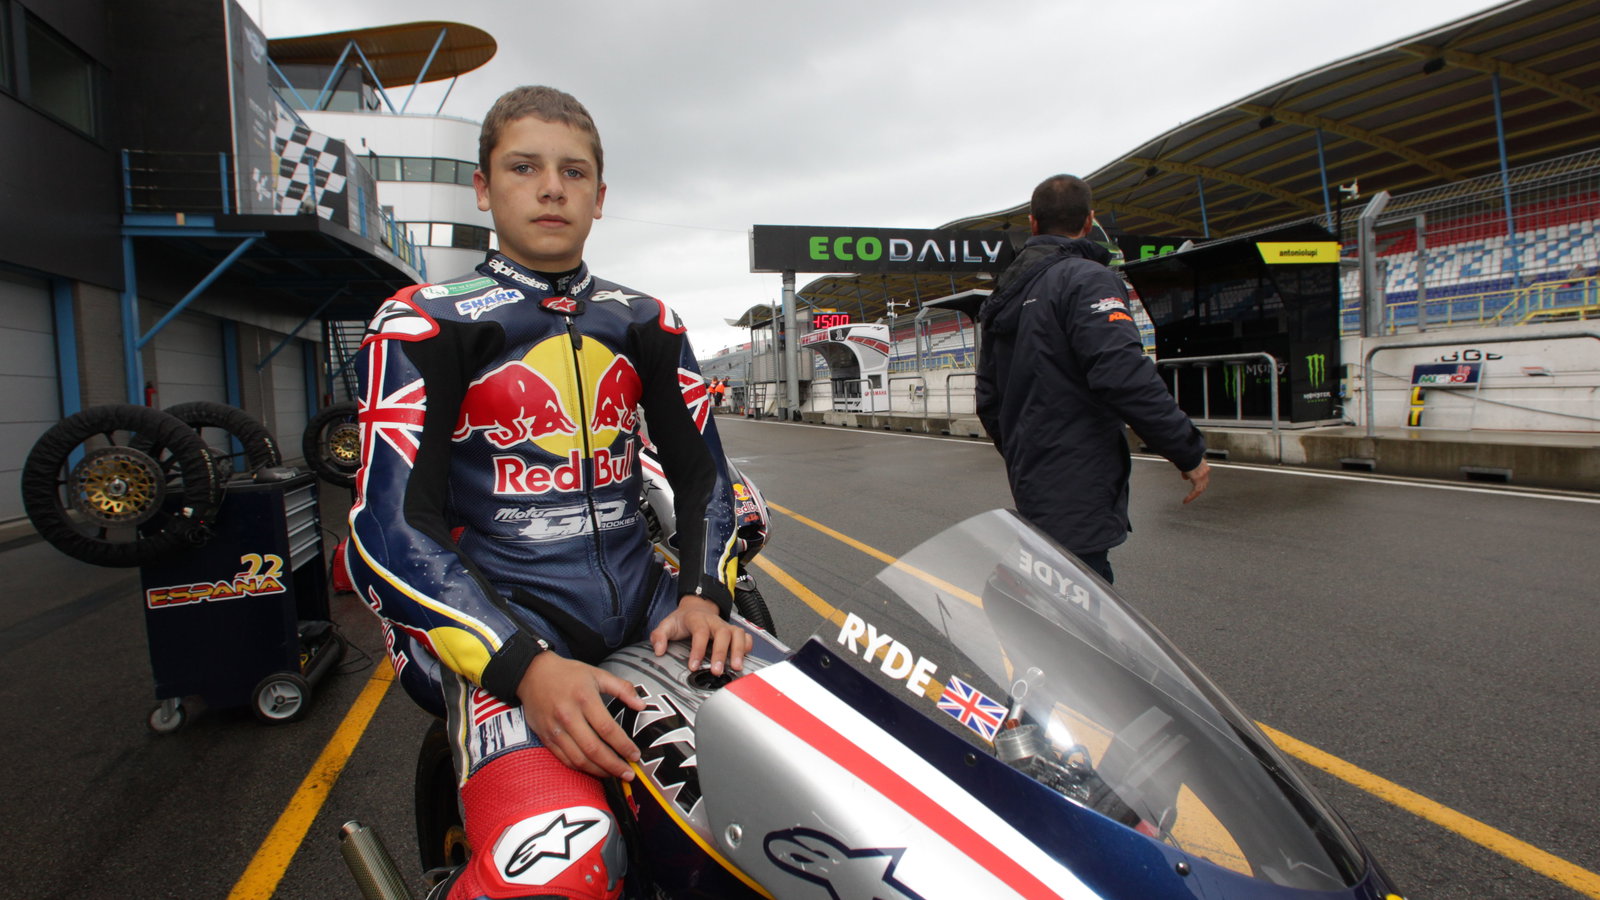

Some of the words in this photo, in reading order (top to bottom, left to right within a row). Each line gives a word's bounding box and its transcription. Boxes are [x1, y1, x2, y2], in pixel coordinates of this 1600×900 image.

[809, 236, 882, 262] ECO
[889, 238, 1003, 263] DAILY
[488, 259, 549, 291] alpinestars
[459, 290, 519, 312] SHARK
[493, 449, 583, 495] Red
[593, 438, 634, 488] Bull
[240, 553, 284, 581] 22
[837, 611, 938, 698] RYDE
